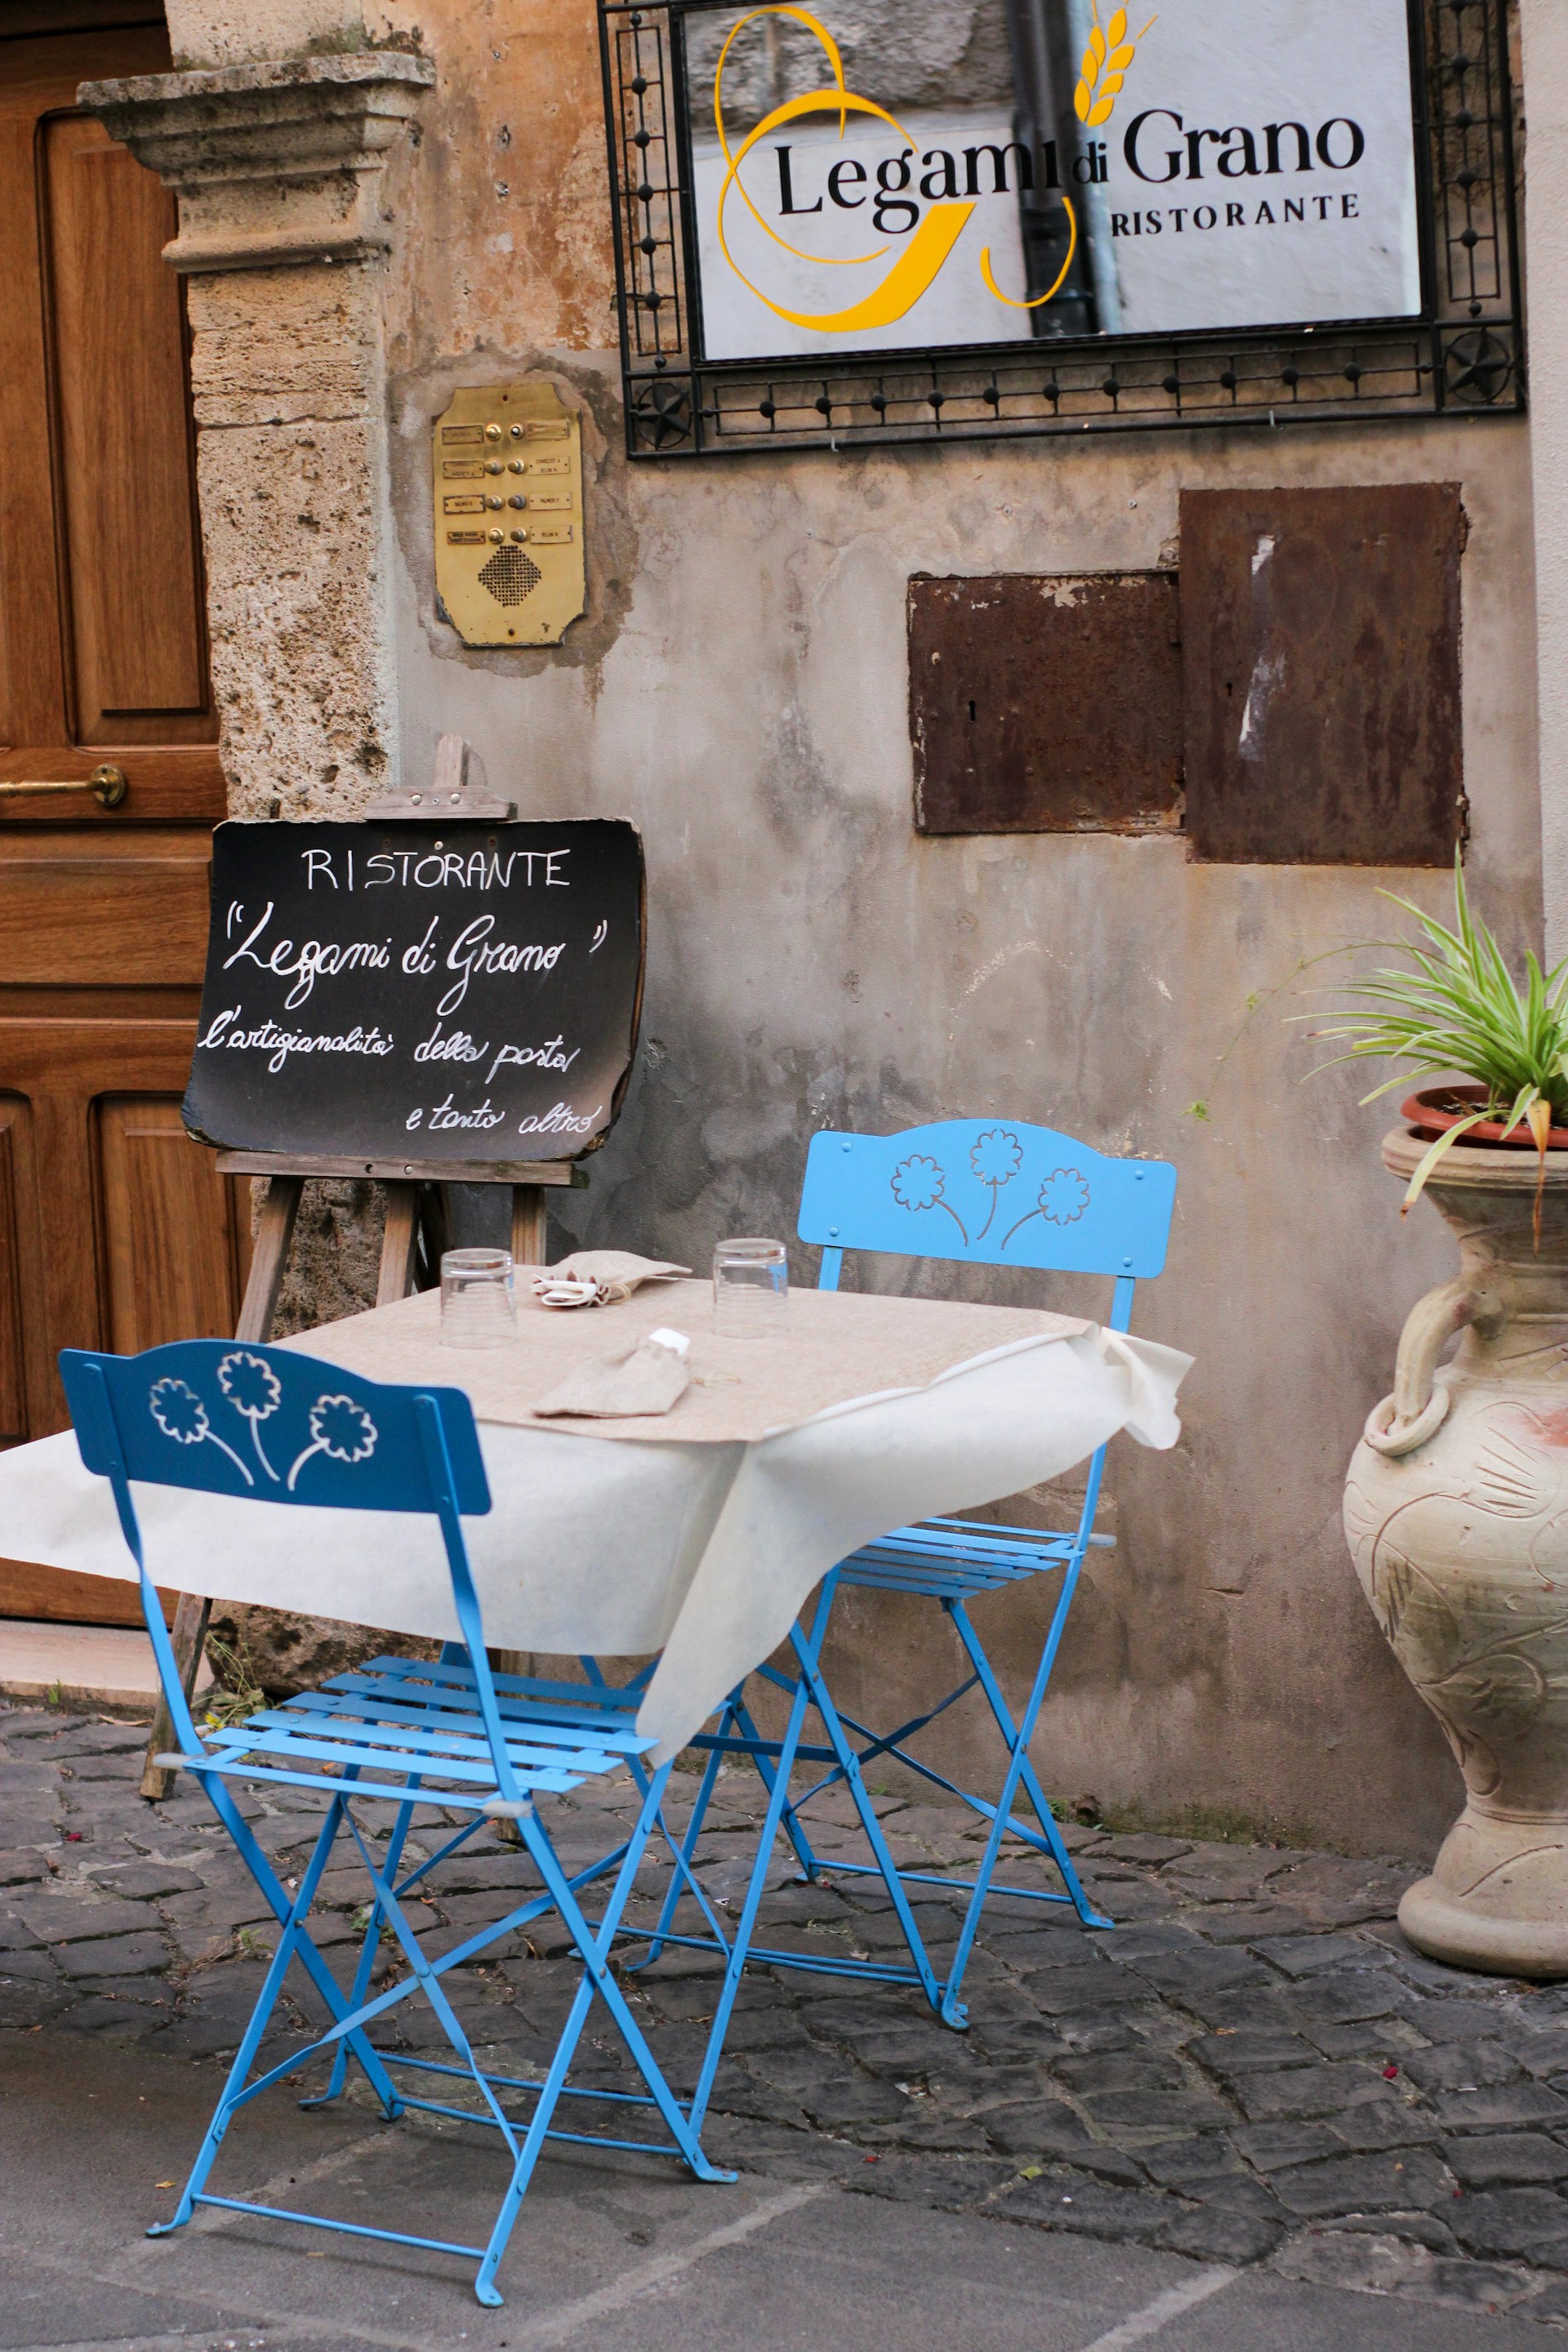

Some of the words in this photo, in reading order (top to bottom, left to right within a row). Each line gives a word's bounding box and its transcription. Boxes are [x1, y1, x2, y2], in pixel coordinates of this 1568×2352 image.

[774, 140, 1062, 234] Legami
[1072, 140, 1110, 184] di
[1123, 109, 1365, 183] Grano
[1111, 193, 1360, 237] RISTORANTE
[301, 849, 571, 891] RISTORANTE
[402, 915, 439, 974] di
[436, 914, 566, 1017] Grano
[197, 1004, 394, 1073] l'artigianalità
[413, 1022, 489, 1062] della
[484, 1034, 581, 1085] pasta
[406, 1107, 423, 1130] e
[429, 1093, 506, 1129] tanto
[519, 1102, 603, 1134] altro
